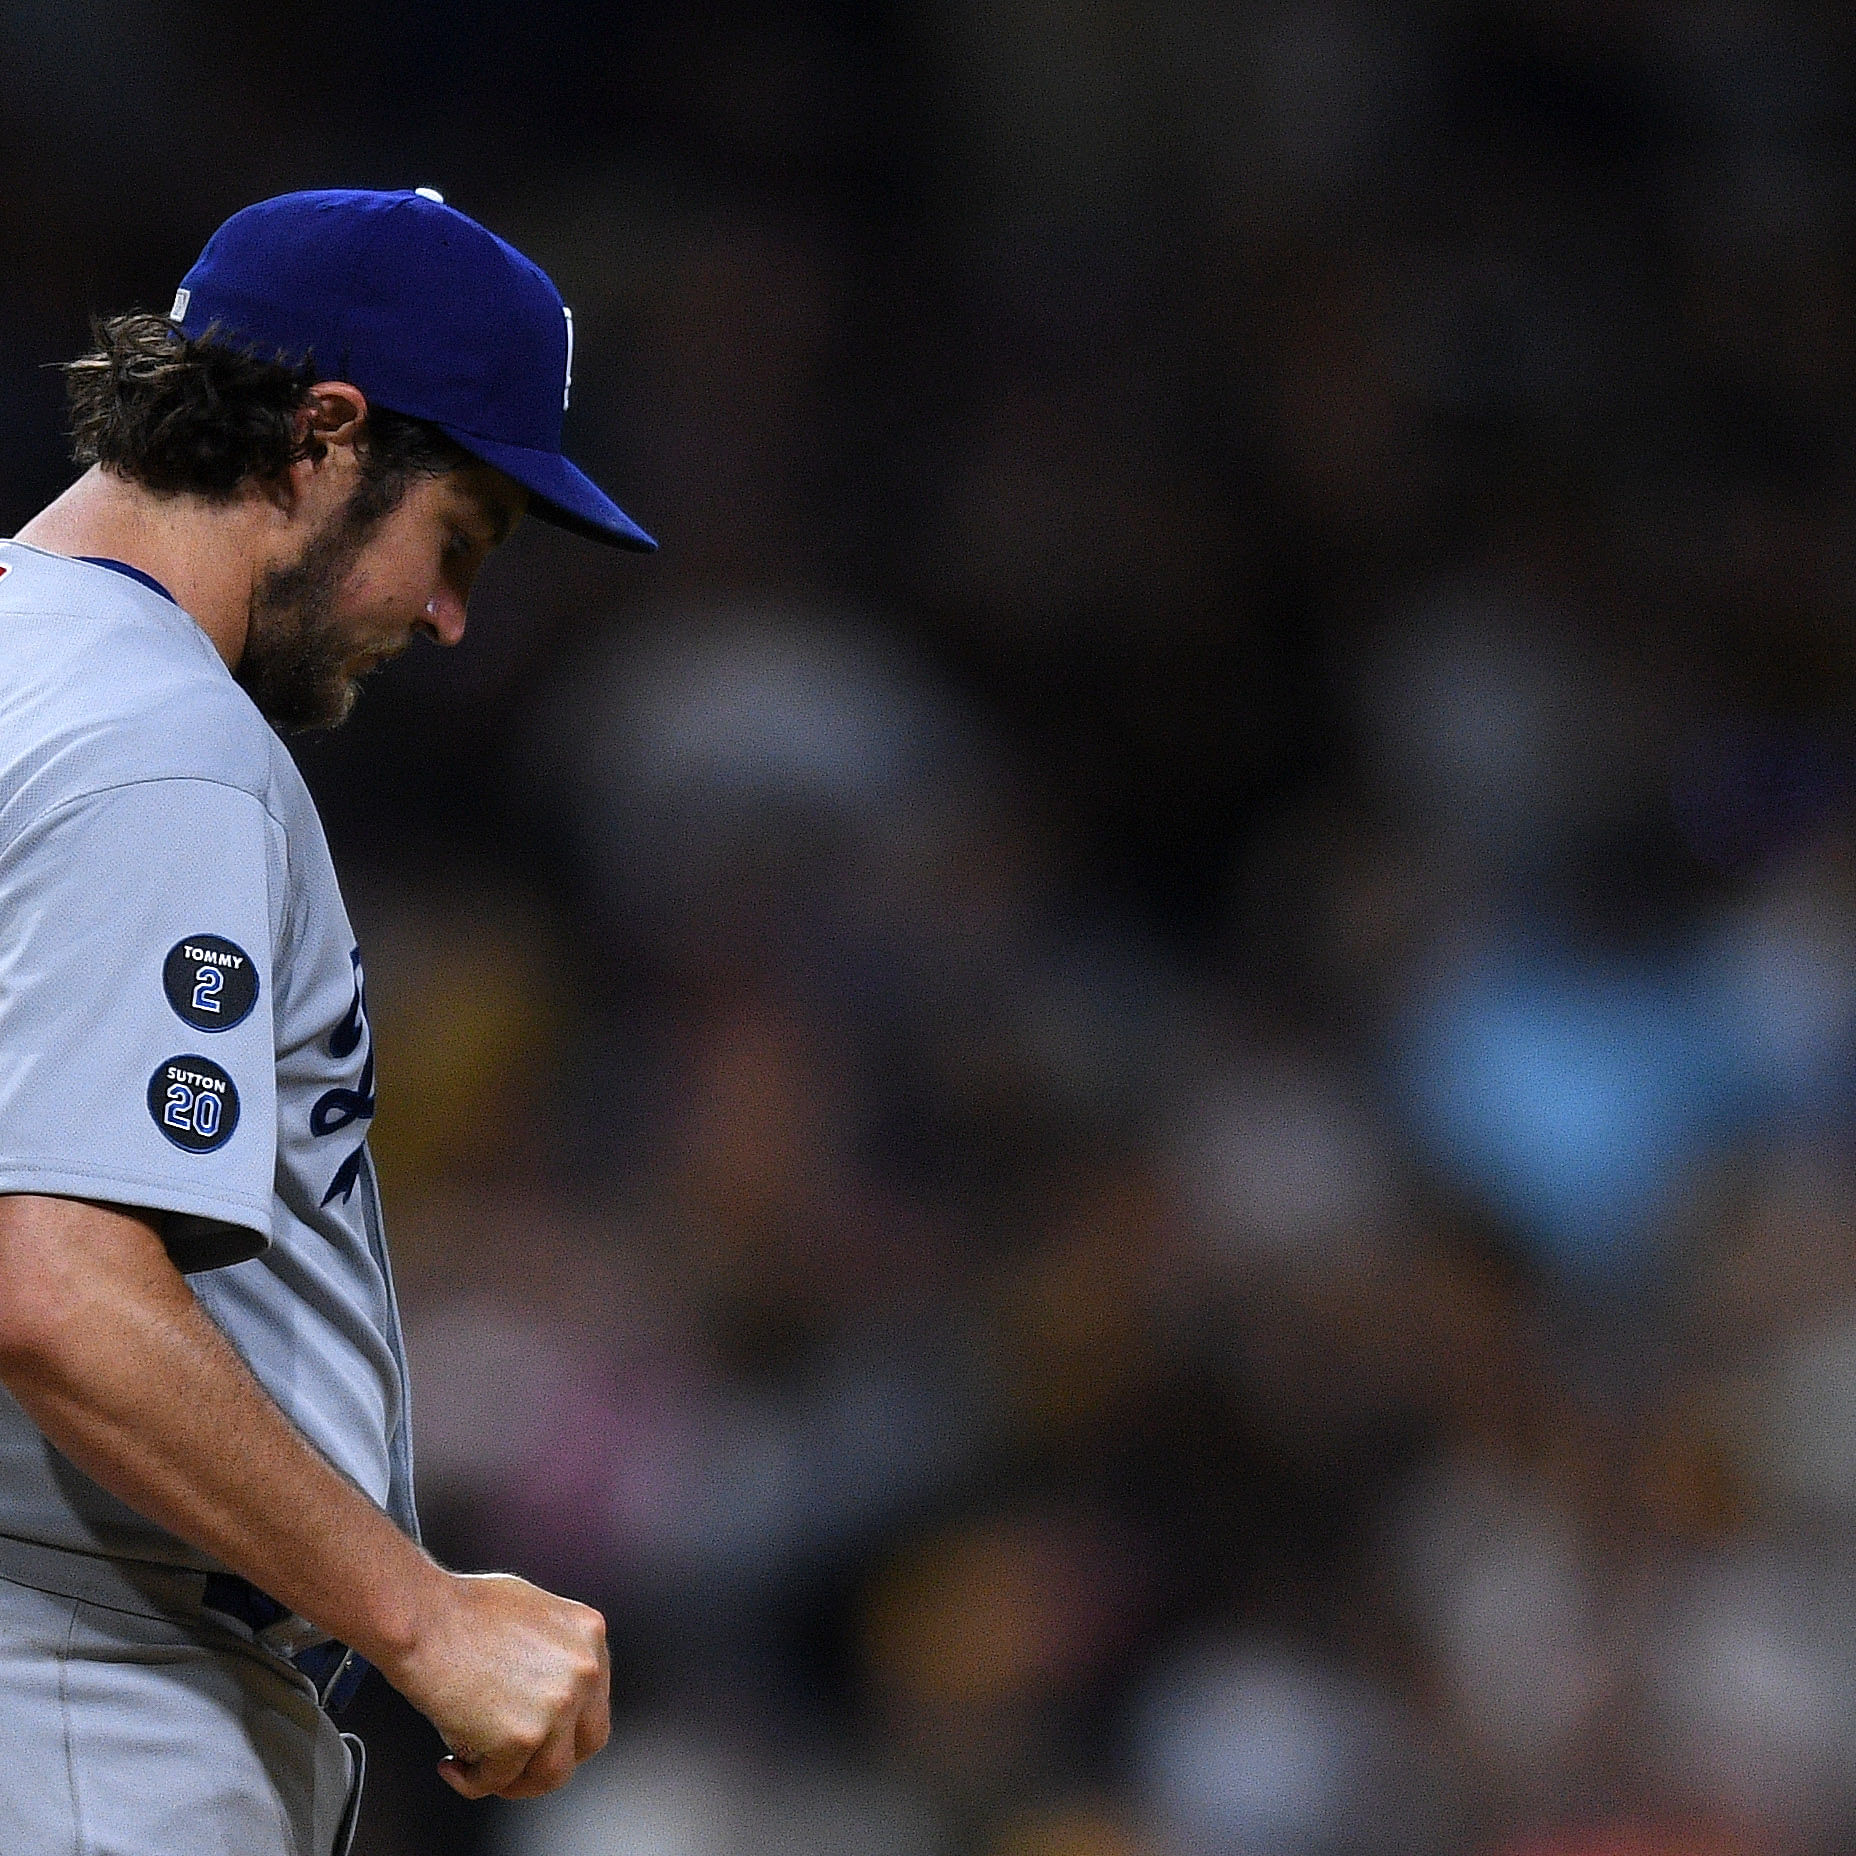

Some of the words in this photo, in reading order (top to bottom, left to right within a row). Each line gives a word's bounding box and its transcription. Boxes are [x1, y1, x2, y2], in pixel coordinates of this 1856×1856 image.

[184, 946, 243, 969] TOMMY
[192, 966, 224, 1012] 2
[167, 1067, 226, 1093] SUTTON
[164, 1083, 222, 1137] 20
